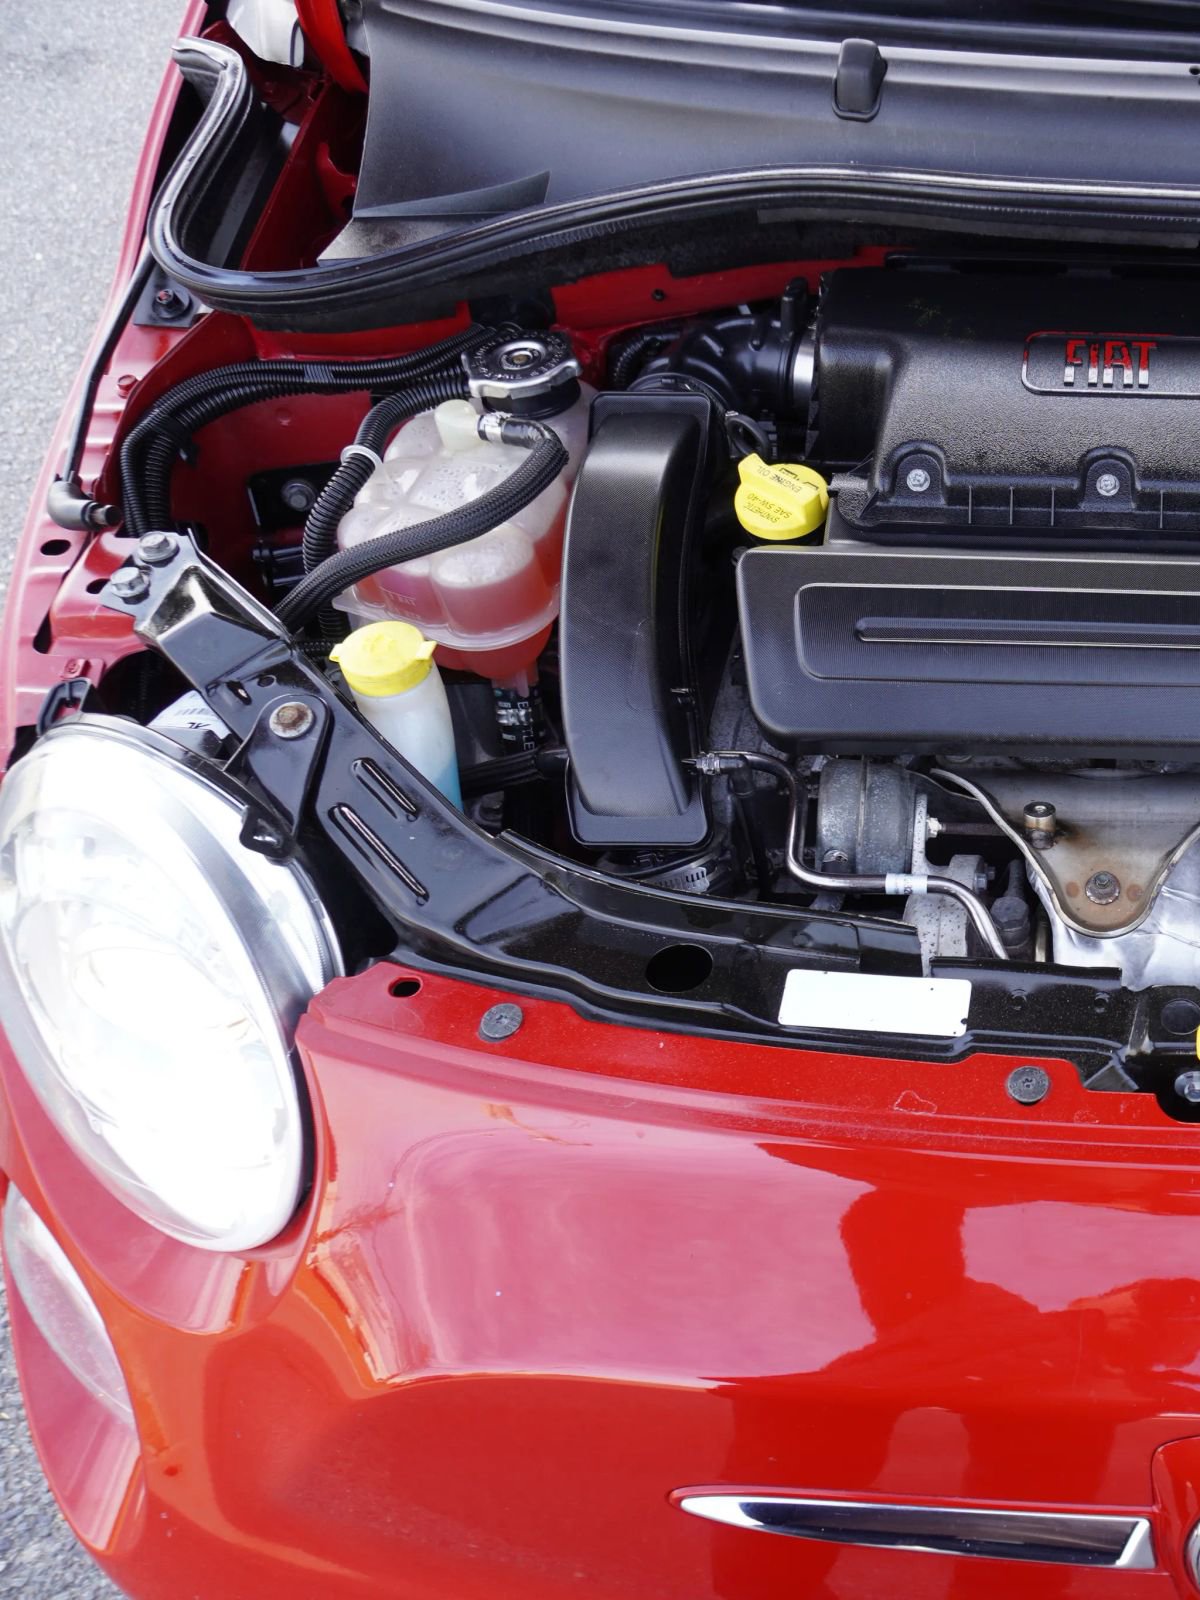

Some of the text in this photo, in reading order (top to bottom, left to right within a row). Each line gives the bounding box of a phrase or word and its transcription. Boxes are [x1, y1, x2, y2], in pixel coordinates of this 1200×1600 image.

[1063, 340, 1158, 388] FIAT
[758, 467, 801, 493] ENGINE OIL
[744, 502, 780, 523] SYNTHETIC
[747, 493, 792, 519] SAE 5W-40
